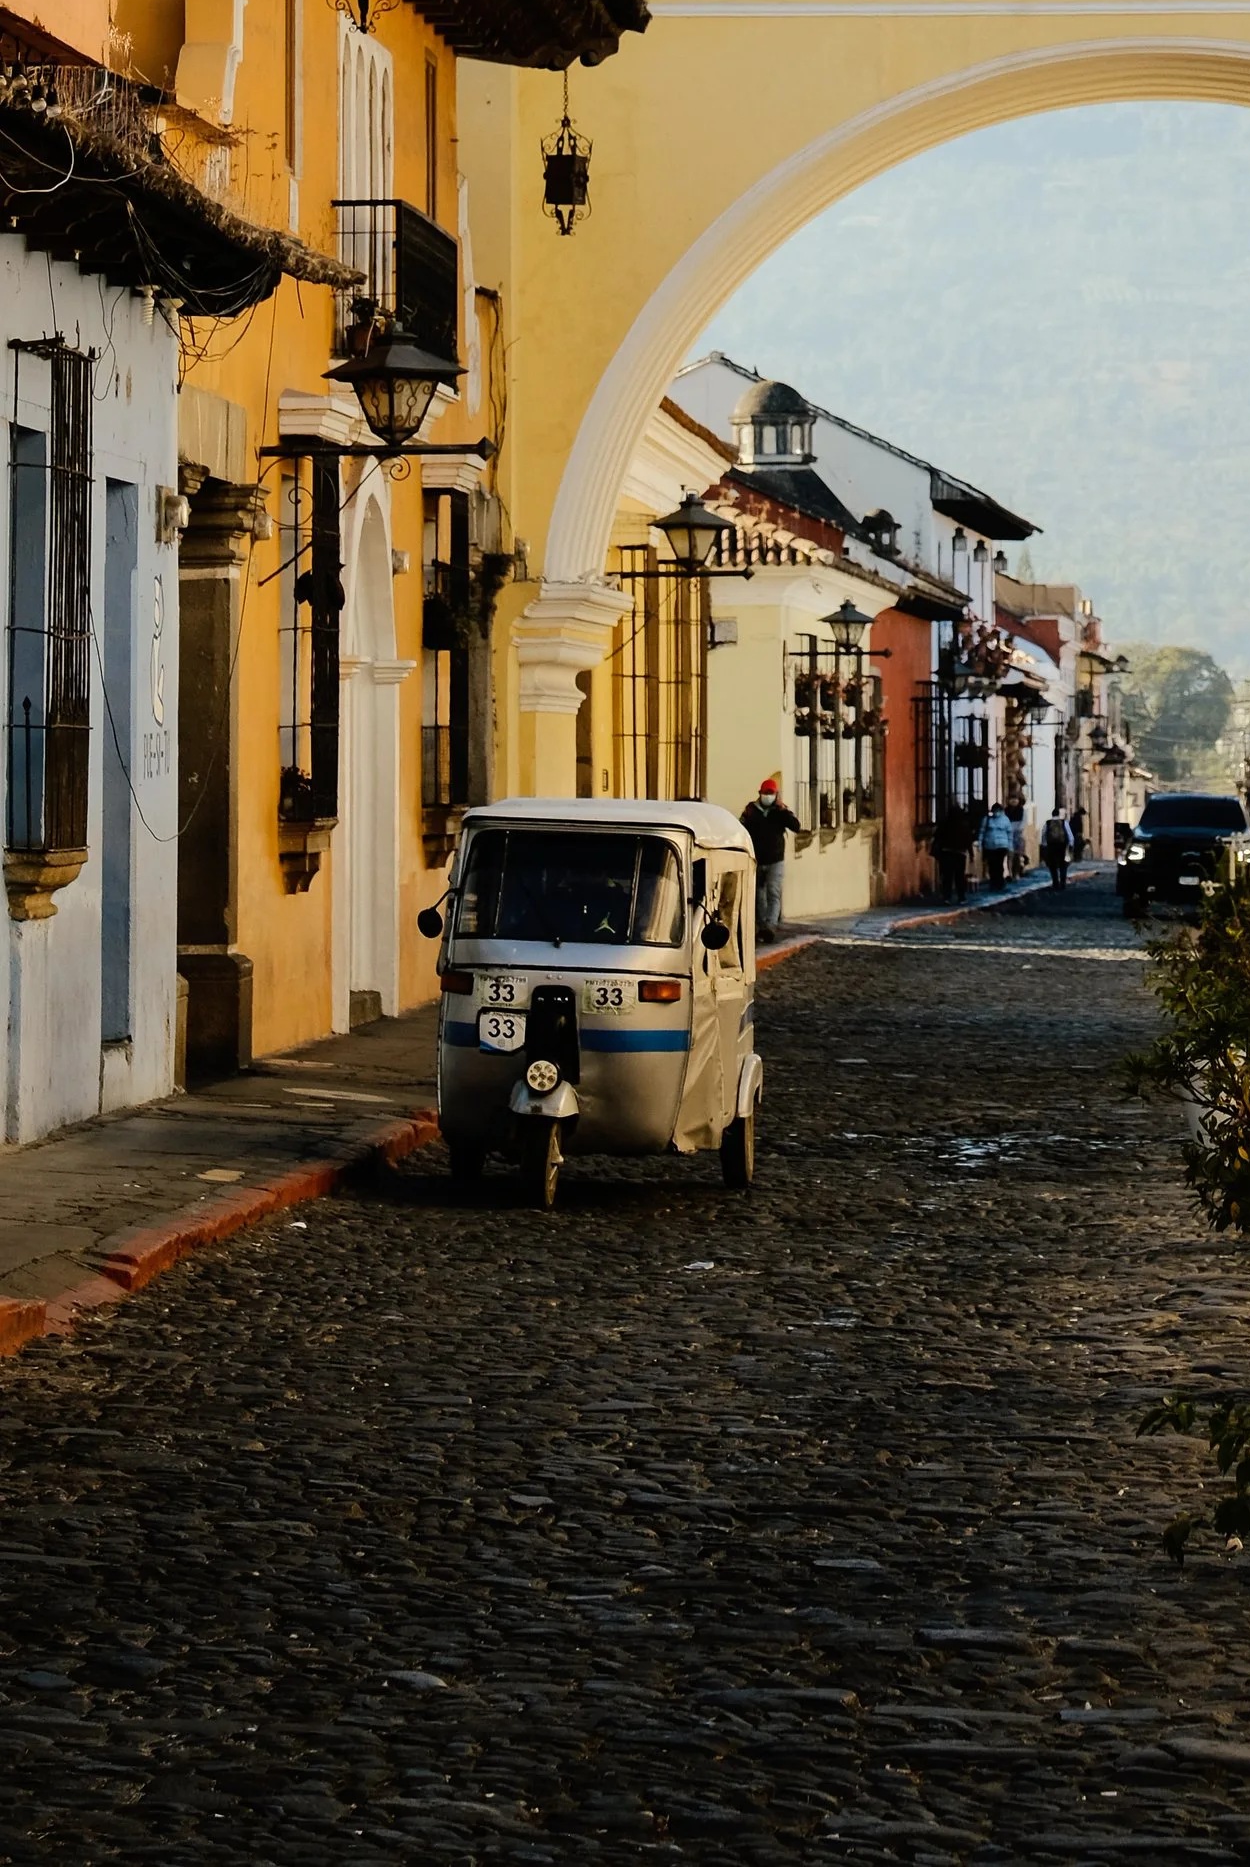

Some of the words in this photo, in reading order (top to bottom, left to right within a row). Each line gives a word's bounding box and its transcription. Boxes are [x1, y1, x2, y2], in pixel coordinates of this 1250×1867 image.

[488, 983, 515, 1002] 33
[595, 987, 623, 1006] 33
[488, 1018, 515, 1039] 33
